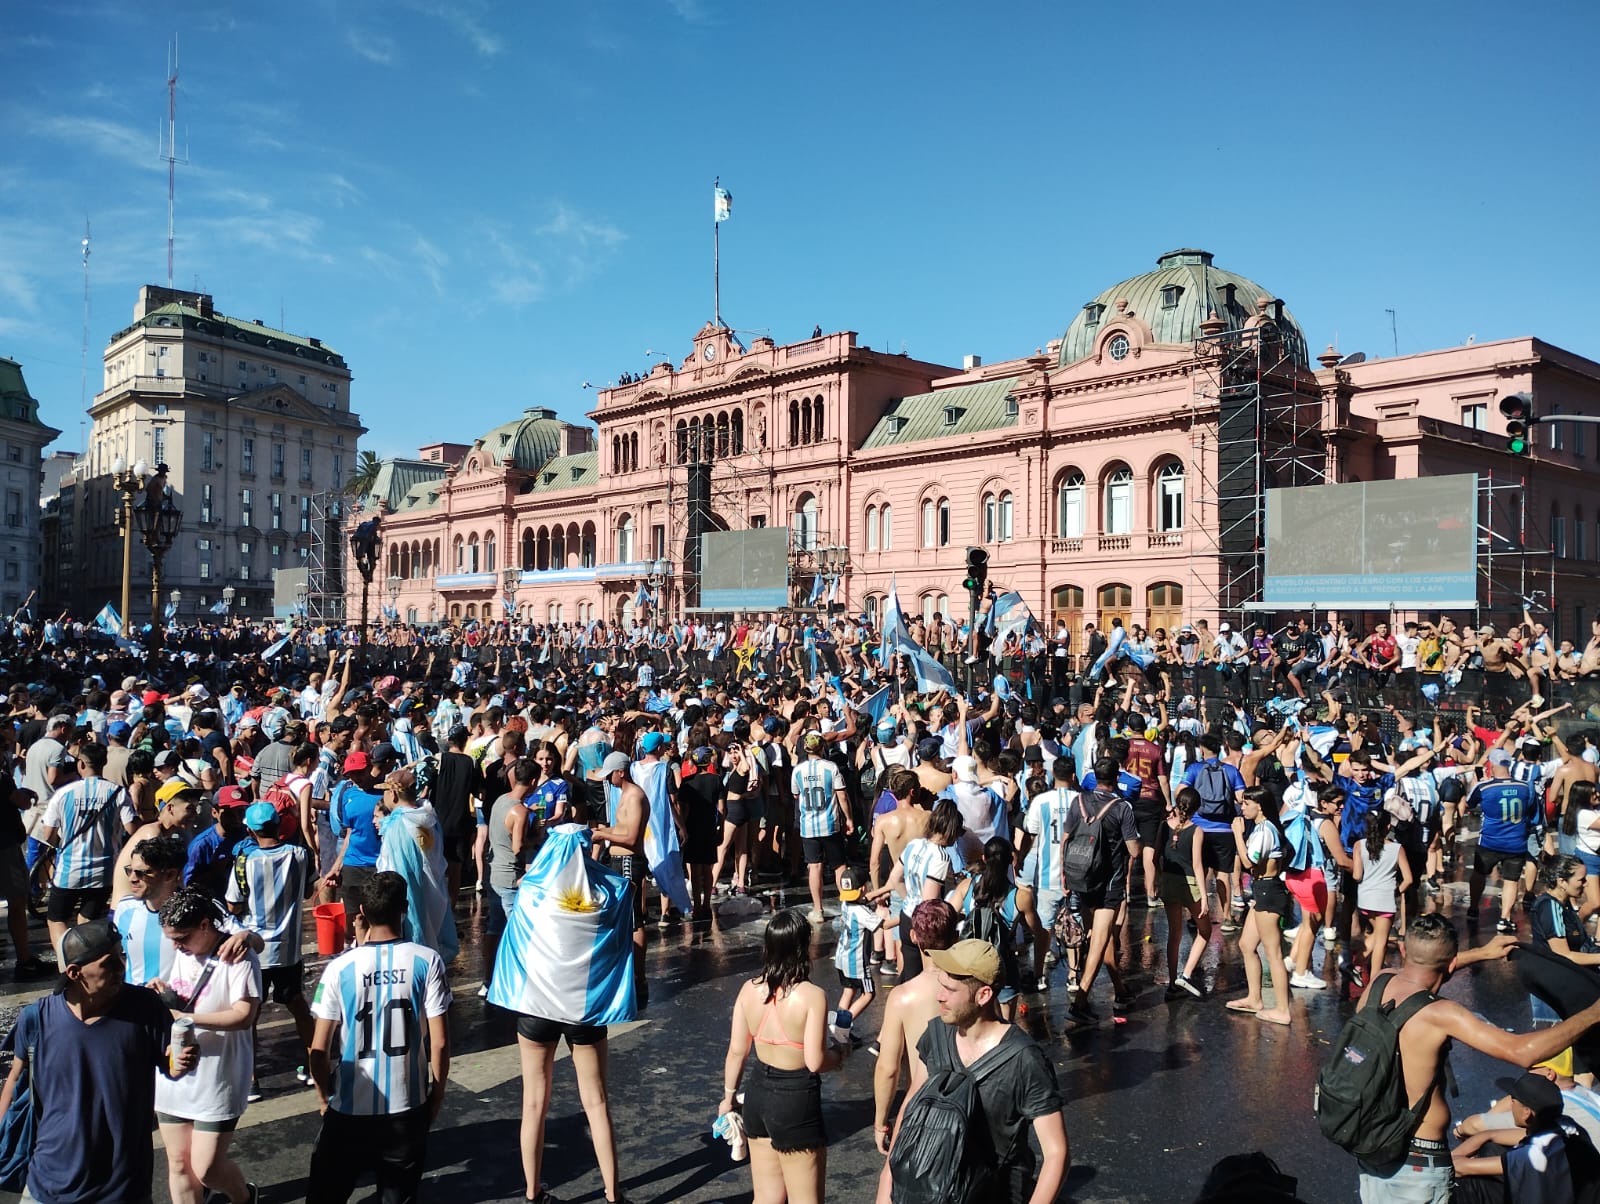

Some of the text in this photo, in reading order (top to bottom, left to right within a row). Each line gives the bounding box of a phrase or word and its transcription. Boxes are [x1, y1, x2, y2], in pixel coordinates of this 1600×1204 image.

[1126, 758, 1152, 778] 45
[804, 787, 826, 811] 10
[1498, 797, 1523, 824] 10
[363, 969, 407, 988] MESSI
[355, 998, 411, 1060] 10
